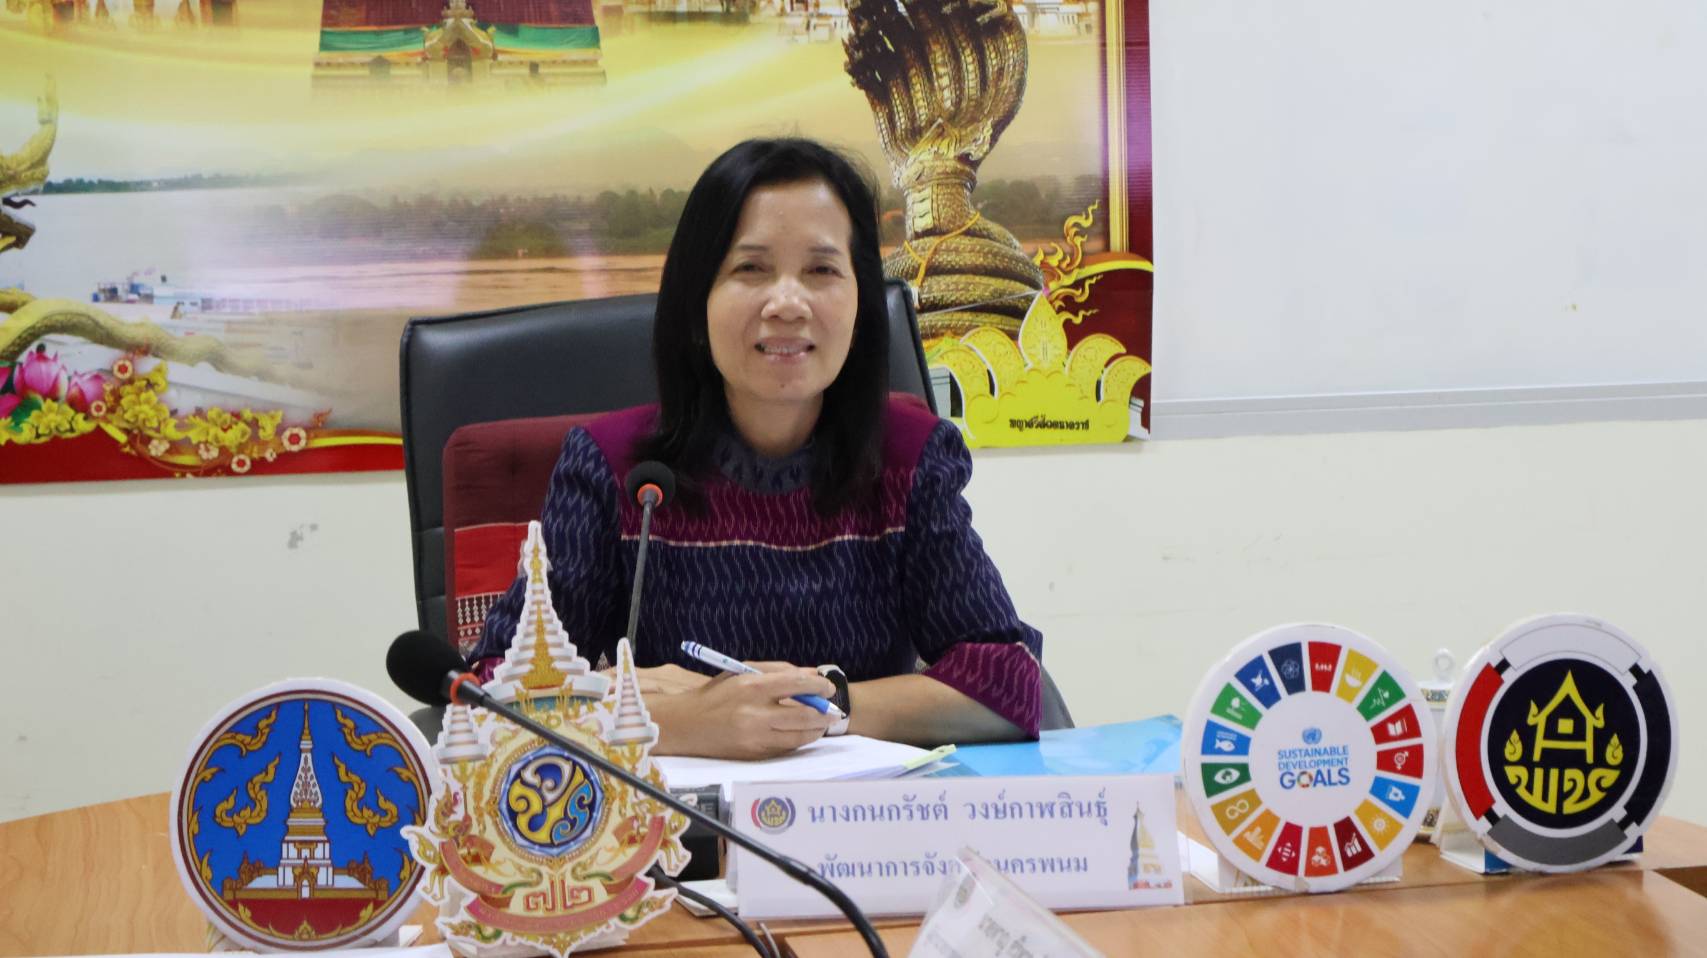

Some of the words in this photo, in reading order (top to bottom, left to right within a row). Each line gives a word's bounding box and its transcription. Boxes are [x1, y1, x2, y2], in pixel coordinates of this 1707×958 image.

[1278, 745, 1349, 760] SUSTAINABLE
[1278, 757, 1348, 771] DEVELOPMENT
[1279, 767, 1351, 790] GOALS
[808, 790, 949, 823] นางกนกรัชต์
[963, 787, 1109, 827] วงษ์กาฬสินธุ์
